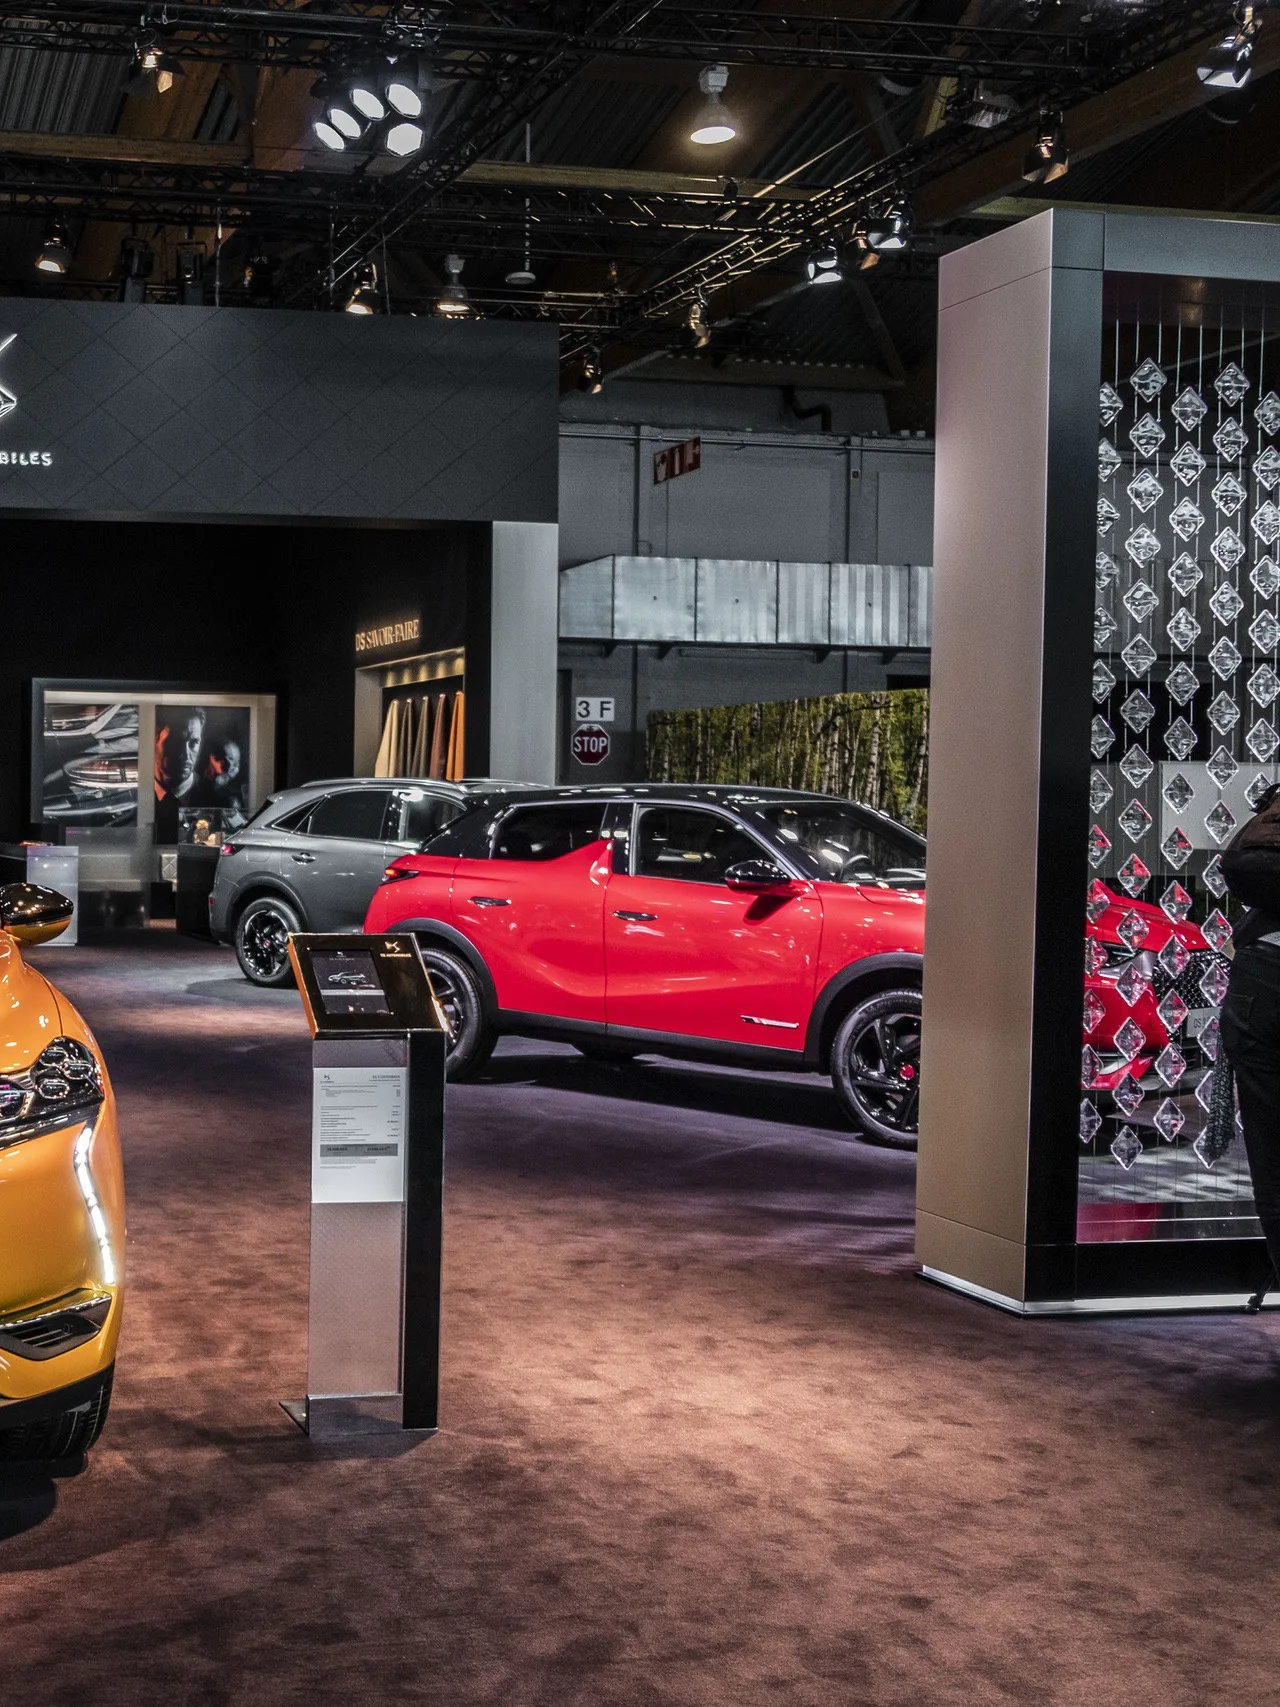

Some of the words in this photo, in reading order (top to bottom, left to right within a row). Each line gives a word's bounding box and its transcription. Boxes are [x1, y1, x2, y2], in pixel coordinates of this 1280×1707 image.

[577, 701, 590, 718] 3
[600, 701, 612, 718] F
[573, 736, 608, 753] STOP
